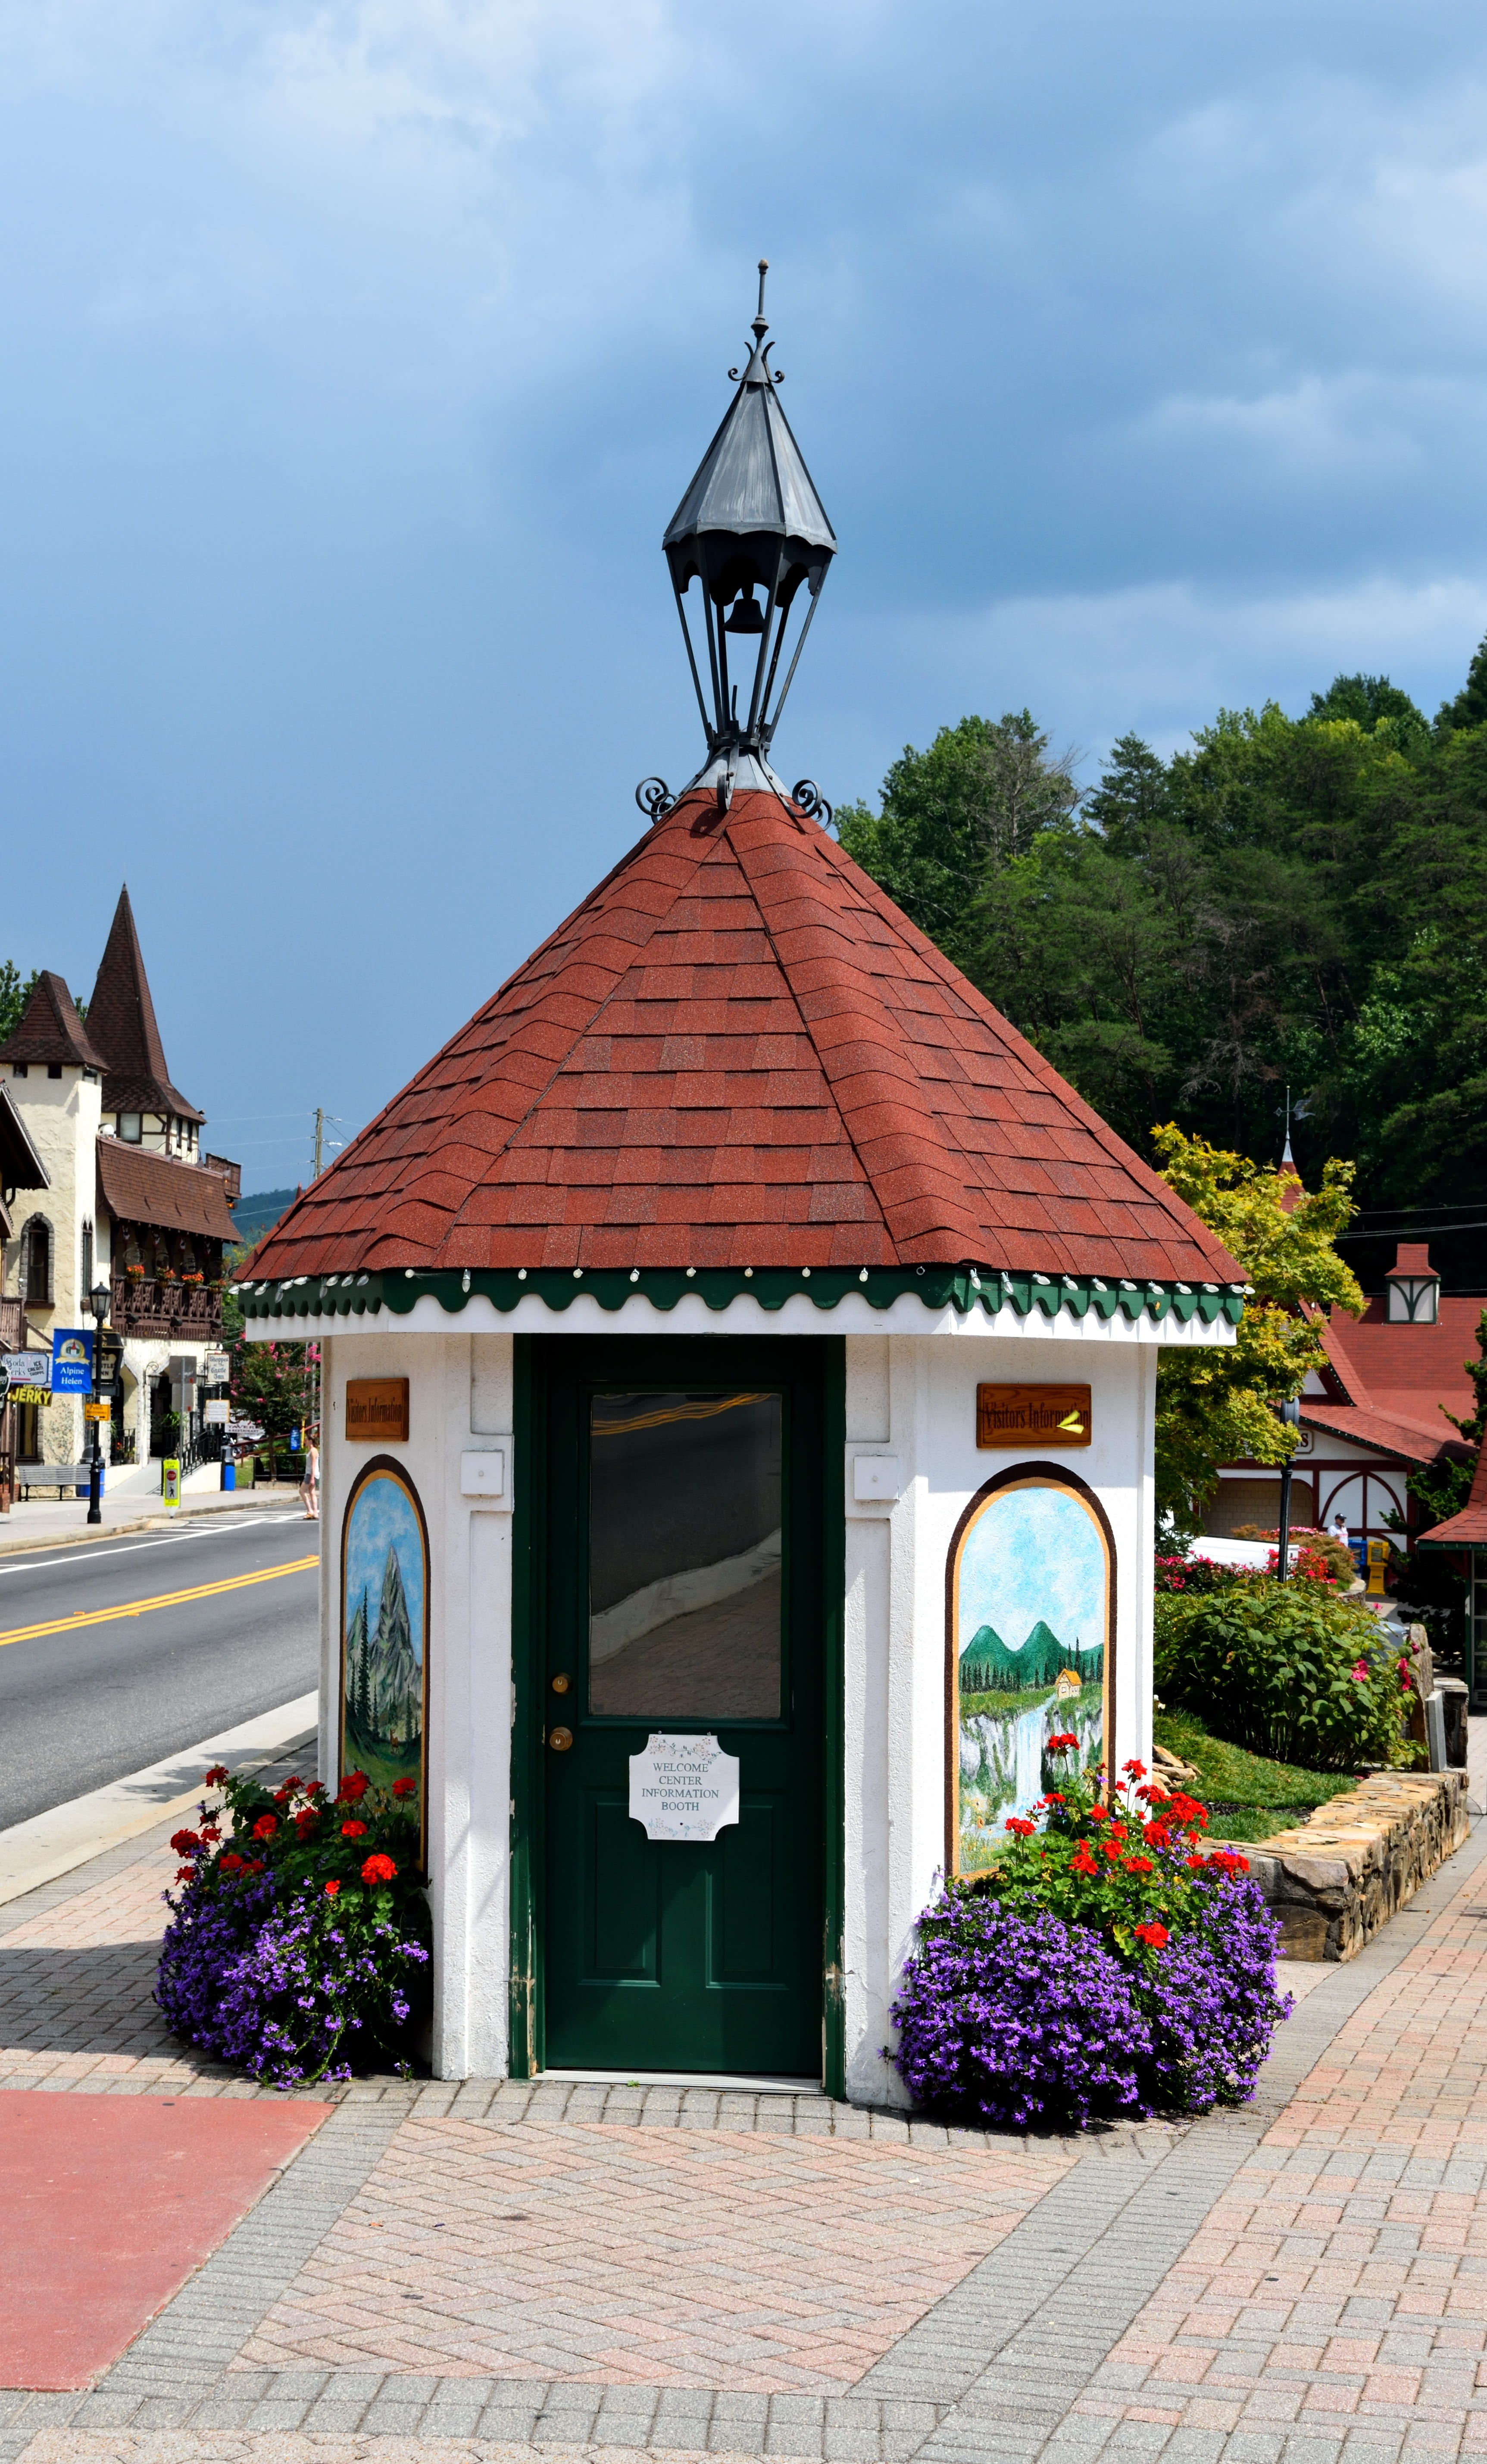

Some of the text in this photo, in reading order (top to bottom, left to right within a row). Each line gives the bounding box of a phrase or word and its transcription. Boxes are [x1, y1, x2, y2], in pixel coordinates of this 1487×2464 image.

[5, 1357, 25, 1368] Soda
[9, 1367, 26, 1376] erks
[60, 1367, 84, 1376] Alpine
[12, 1388, 51, 1404] JERKY
[347, 1397, 401, 1423] Visitors Information
[985, 1402, 1025, 1429] Visitors
[653, 1763, 709, 1773] WELCOME
[659, 1776, 703, 1785] CENTER
[642, 1789, 719, 1799] INFORMATION
[662, 1802, 700, 1811] BOOTH
